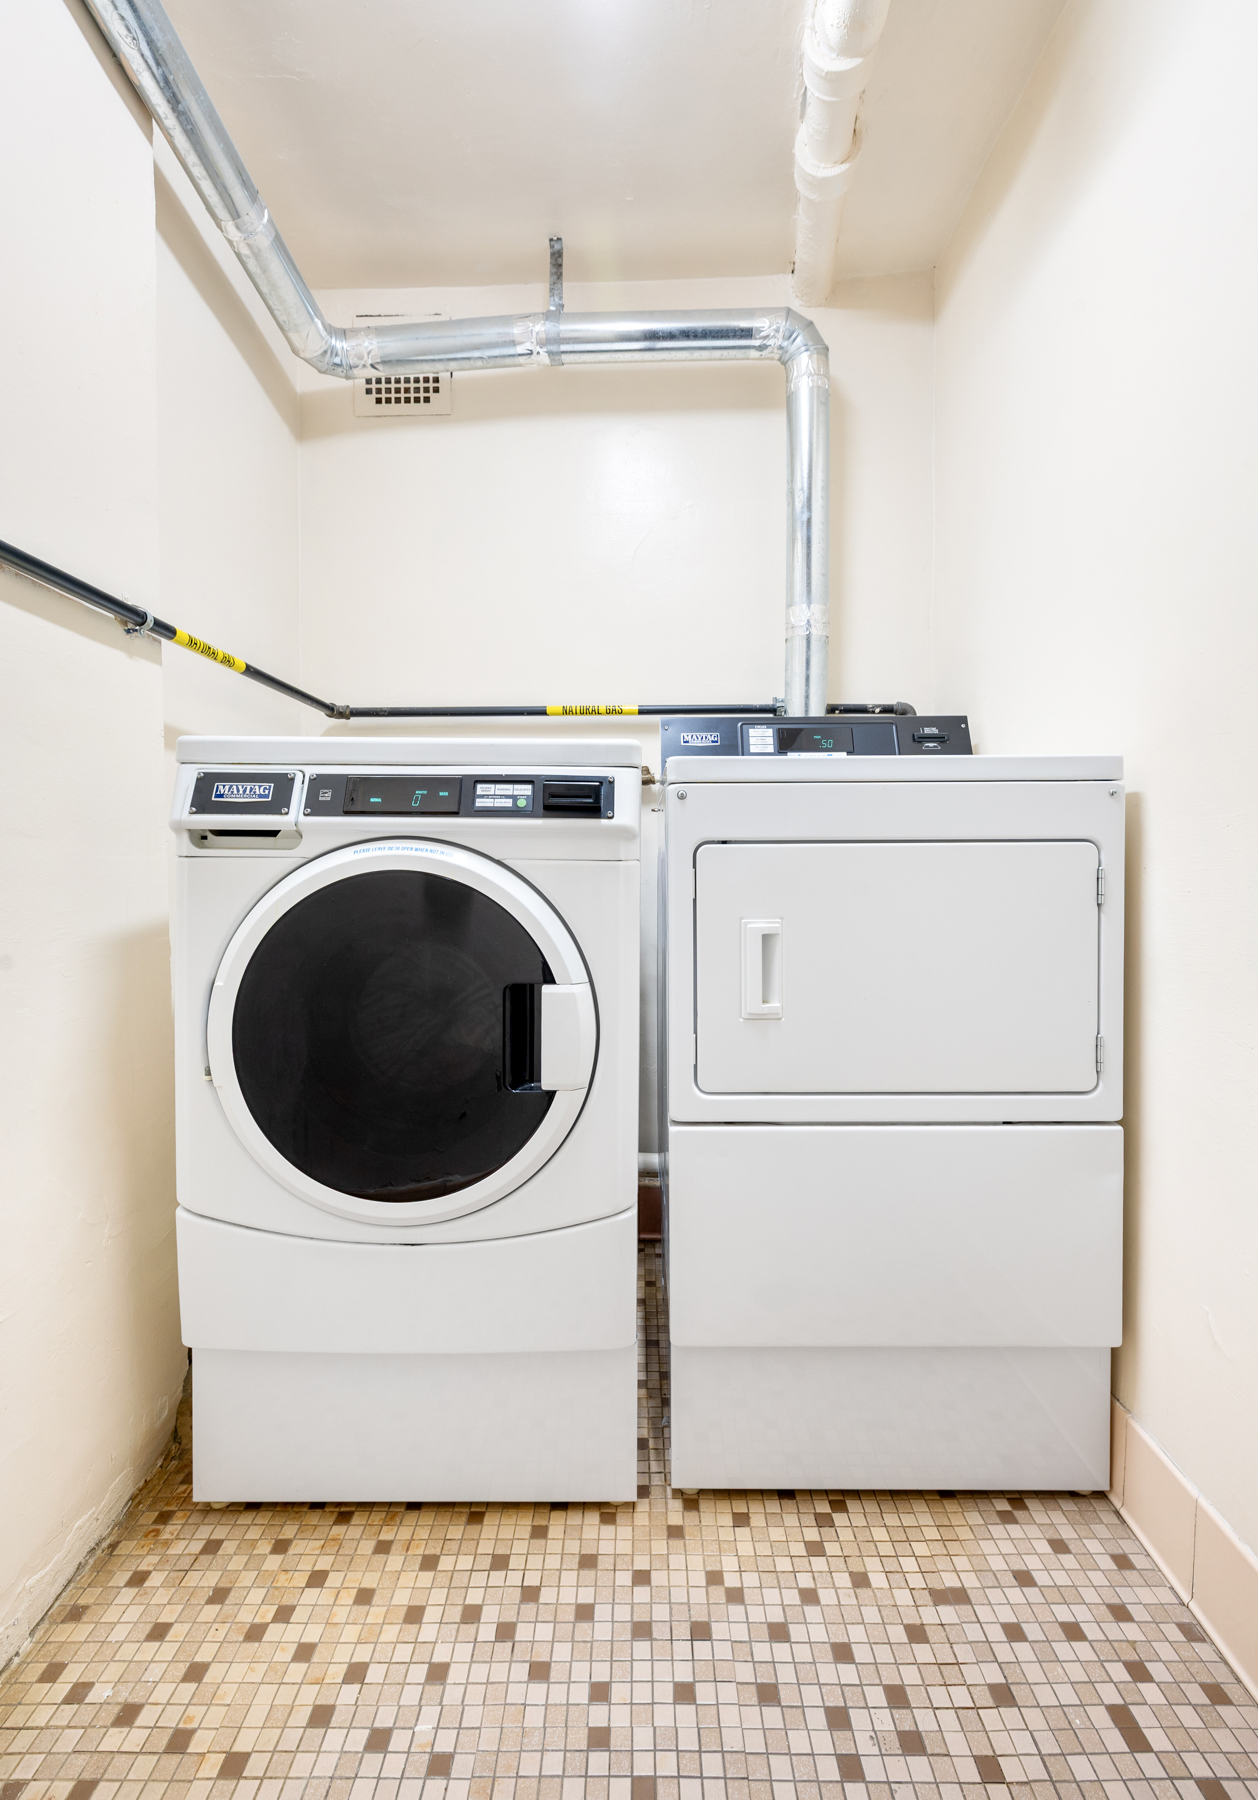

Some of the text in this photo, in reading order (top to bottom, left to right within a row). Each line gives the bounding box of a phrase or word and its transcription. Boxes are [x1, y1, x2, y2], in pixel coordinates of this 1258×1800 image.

[562, 705, 623, 715] NATURAL GAS
[216, 785, 269, 794] MAYTAG
